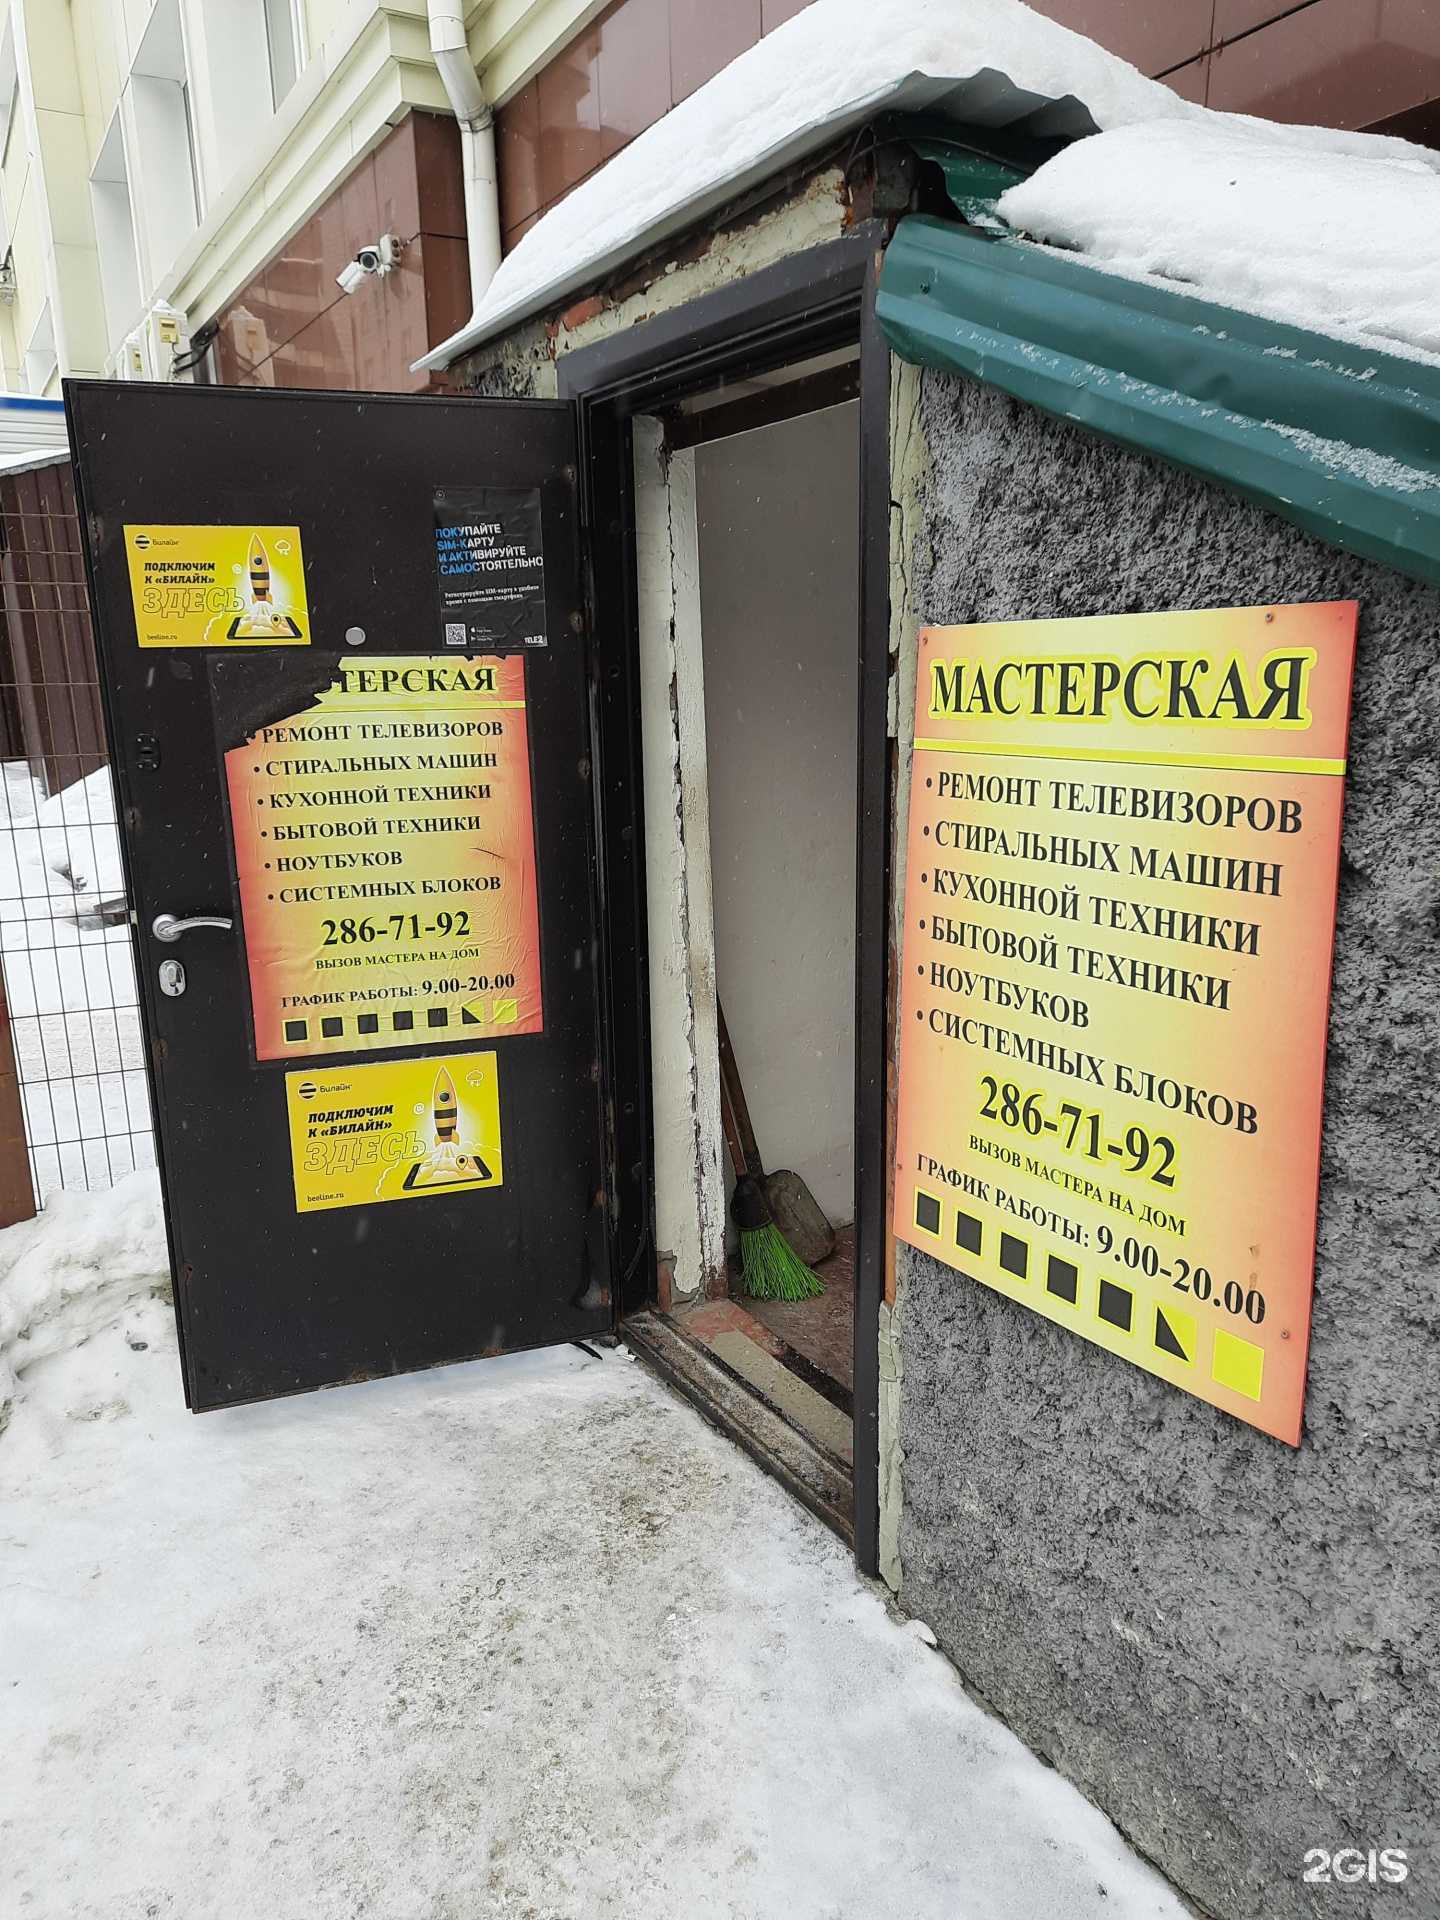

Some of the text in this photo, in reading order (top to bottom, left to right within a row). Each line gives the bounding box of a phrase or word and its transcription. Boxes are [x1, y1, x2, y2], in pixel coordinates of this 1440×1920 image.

[435, 523, 501, 537] ПОКУПАЙТЕ
[437, 537, 495, 551] SIM-КАРТУ
[438, 546, 526, 562] И АКТИВИРУЙТЕ
[144, 562, 215, 573] ПОДКЛЮЧИМ
[144, 573, 215, 584] К «БИЛАЙН»
[440, 557, 543, 575] САМОСТОЯТЕЛЬНО
[143, 587, 245, 619] ЗДЕСЬ
[932, 656, 1310, 720] МАСТЕРСКАЯ
[263, 721, 503, 743] РЕМОНТ ТЕЛЕВИЗОРОВ
[265, 753, 497, 776] СТИРАЛЬНЫХ МАШИН
[269, 784, 491, 809] КУХОННОЙ ТЕХНИКИ
[937, 771, 1303, 834] РЕМОНТ ТЕЛЕВИЗОРОВ
[273, 816, 481, 841] БЫТОВОЙ ТЕХНИКИ
[277, 851, 402, 872] НОУТБУКОВ
[935, 820, 1284, 897] СТИРАЛЬНЫХ МАШИН
[279, 876, 501, 904] СИСТЕМНЫХ БЛОКОВ
[933, 867, 1262, 956] КУХОННОЙ ТЕХНИКИ
[321, 911, 471, 946] 286-71-92
[315, 948, 479, 970] ВЫЗОВ МАСТЕРА НА ДОМ
[930, 916, 1232, 1011] БЫТОВОЙ ТЕХНИКИ
[281, 973, 516, 1008] ГРАФИК РАБОТЫ: 9.00-20.00
[930, 961, 1090, 1028] НОУТБУКОВ
[928, 1009, 1259, 1135] СИСТЕМНЫХ БЛОКОВ
[308, 1104, 394, 1123] ПОДКЛЮЧИМ
[308, 1121, 392, 1138] К «БИЛАЙН»
[978, 1076, 1177, 1188] 286-71-92
[304, 1131, 427, 1175] ЗДЕСЬ
[307, 1192, 344, 1202] beeline.ru
[968, 1134, 1187, 1237] ВЫЗОВ МАСТЕРА НА ДОМ
[917, 1153, 1267, 1325] ГРАФИК РАБОТЫ: 9.00-20.00
